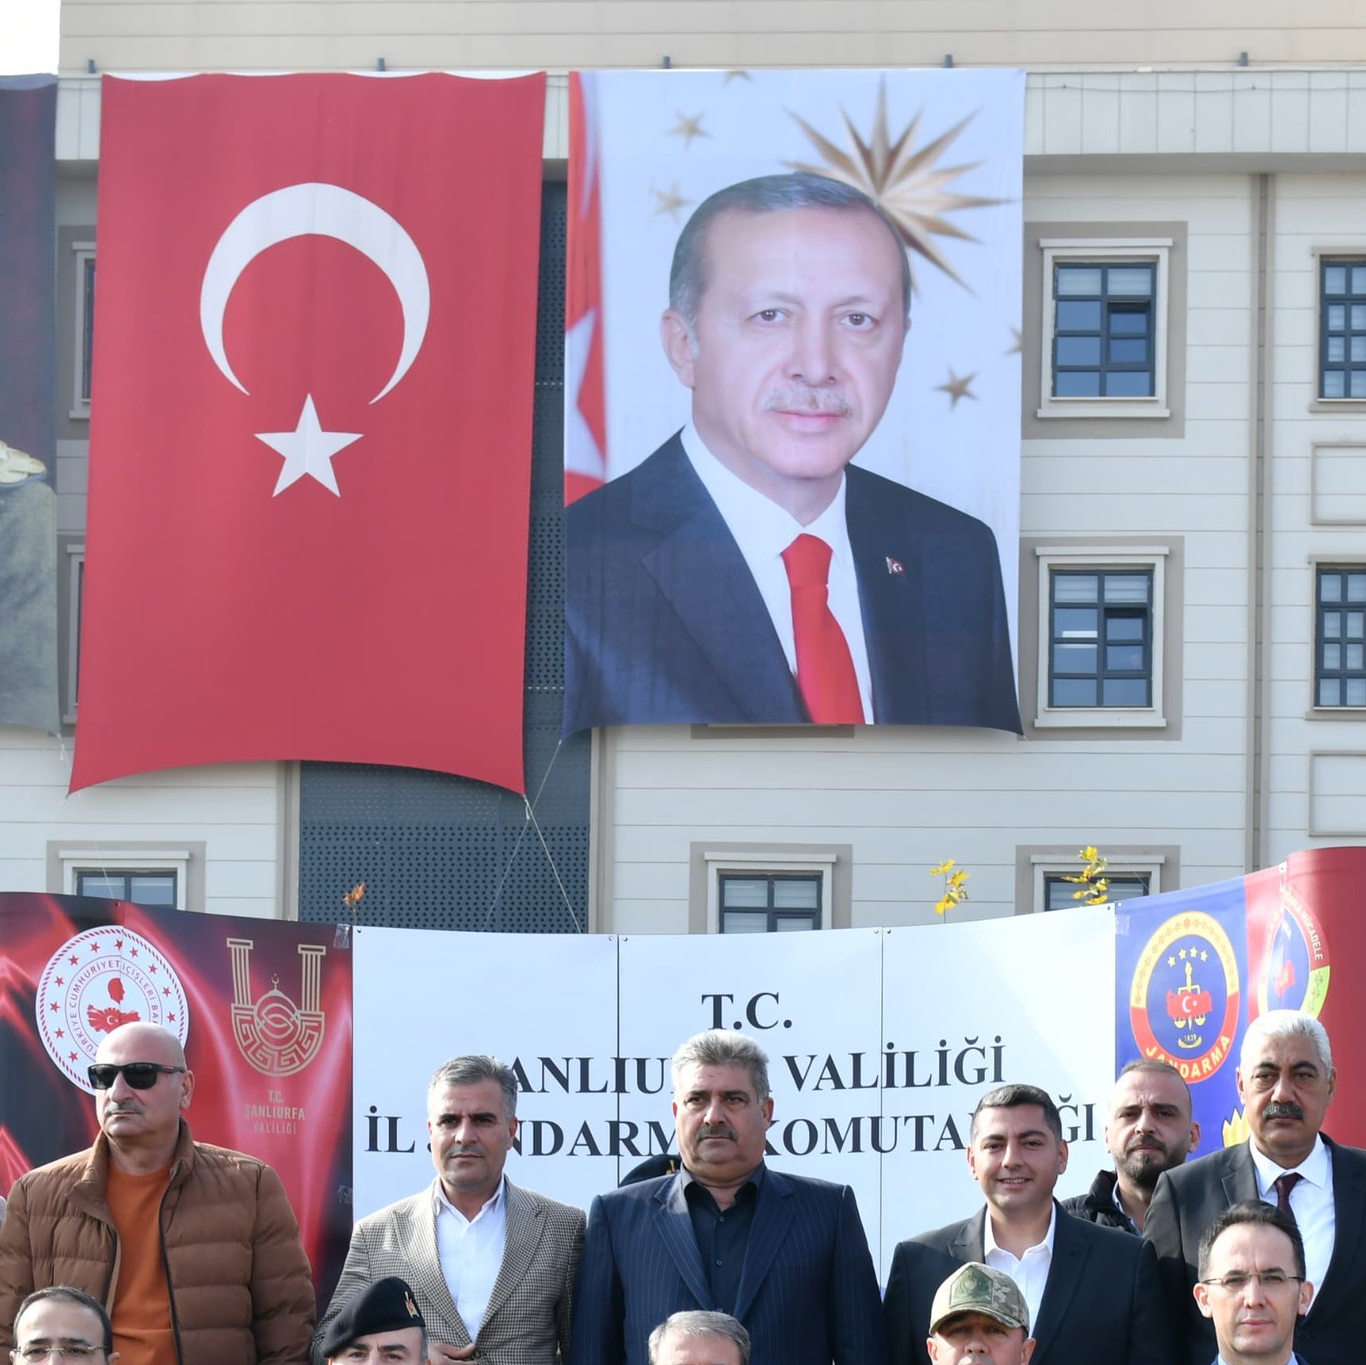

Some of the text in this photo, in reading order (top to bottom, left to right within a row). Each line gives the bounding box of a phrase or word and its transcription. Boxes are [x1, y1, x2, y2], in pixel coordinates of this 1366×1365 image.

[700, 991, 793, 1030] T.C.
[782, 1035, 1007, 1093] VALİLİĞİ
[364, 1105, 416, 1154] İL
[763, 1094, 1098, 1157] KOMUTAĞI
